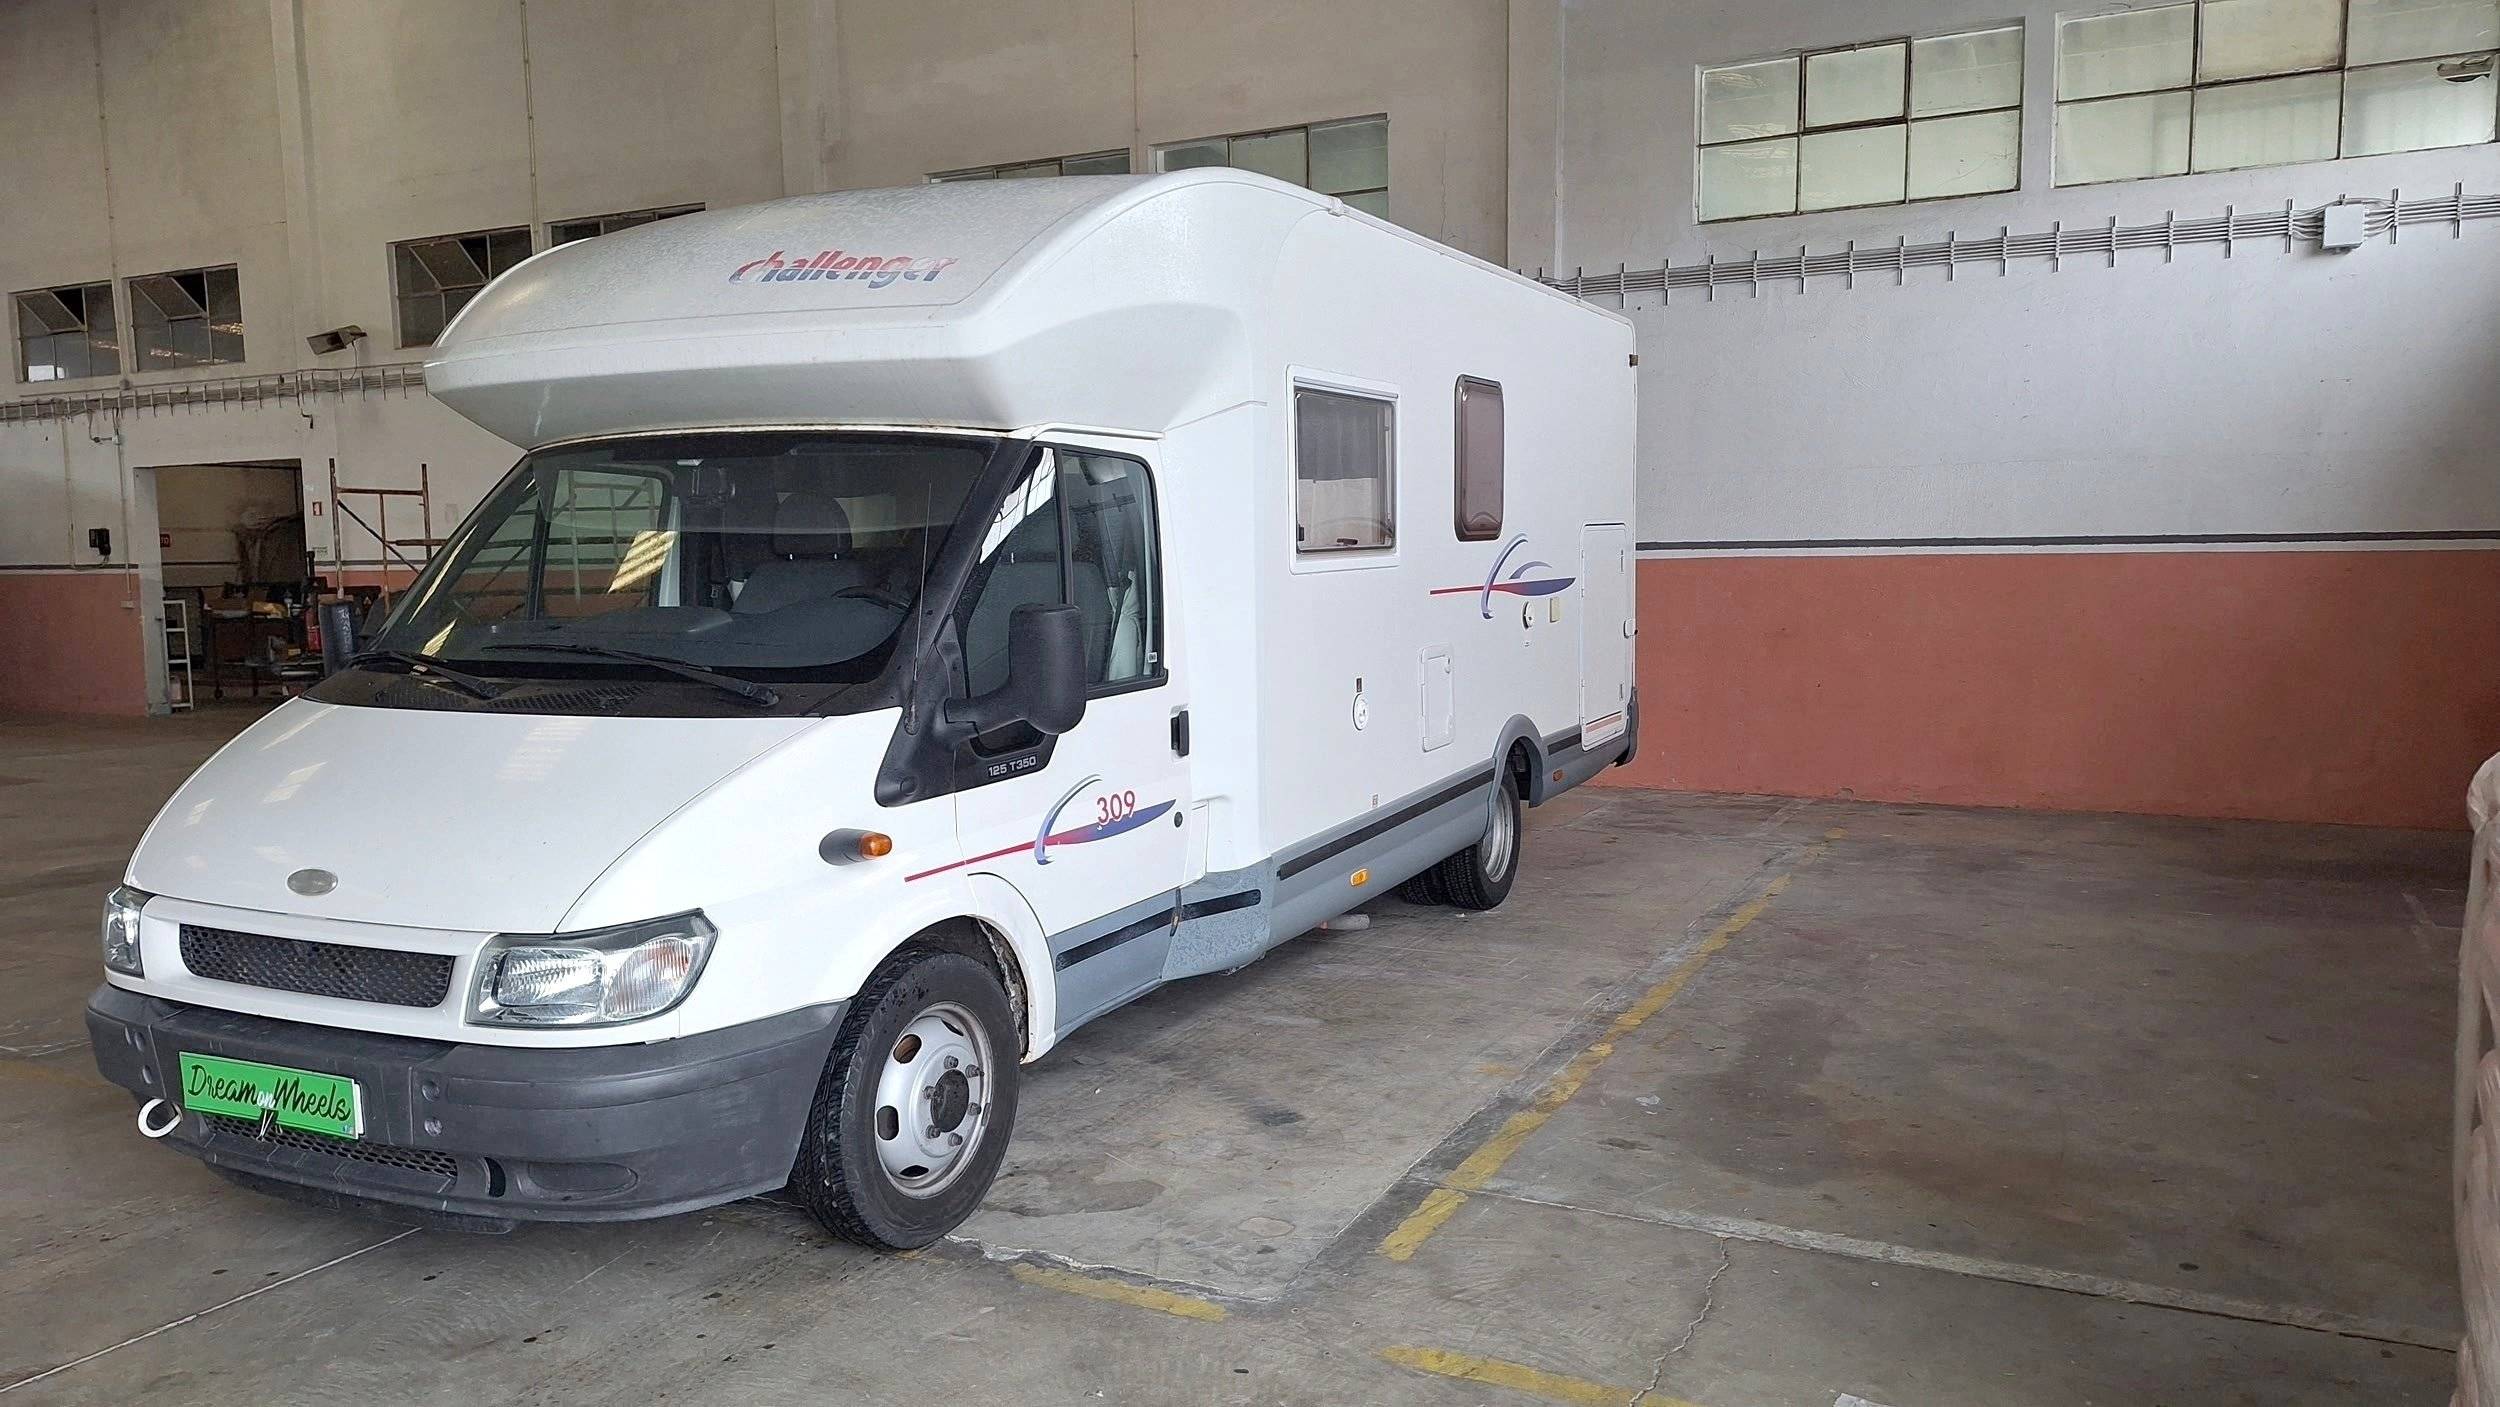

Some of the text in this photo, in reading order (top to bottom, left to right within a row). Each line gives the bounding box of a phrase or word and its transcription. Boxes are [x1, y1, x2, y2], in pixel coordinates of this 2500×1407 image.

[988, 756, 1036, 776] 125 T350
[1096, 790, 1135, 824] 309
[188, 1064, 351, 1121] Dream on Wheels
